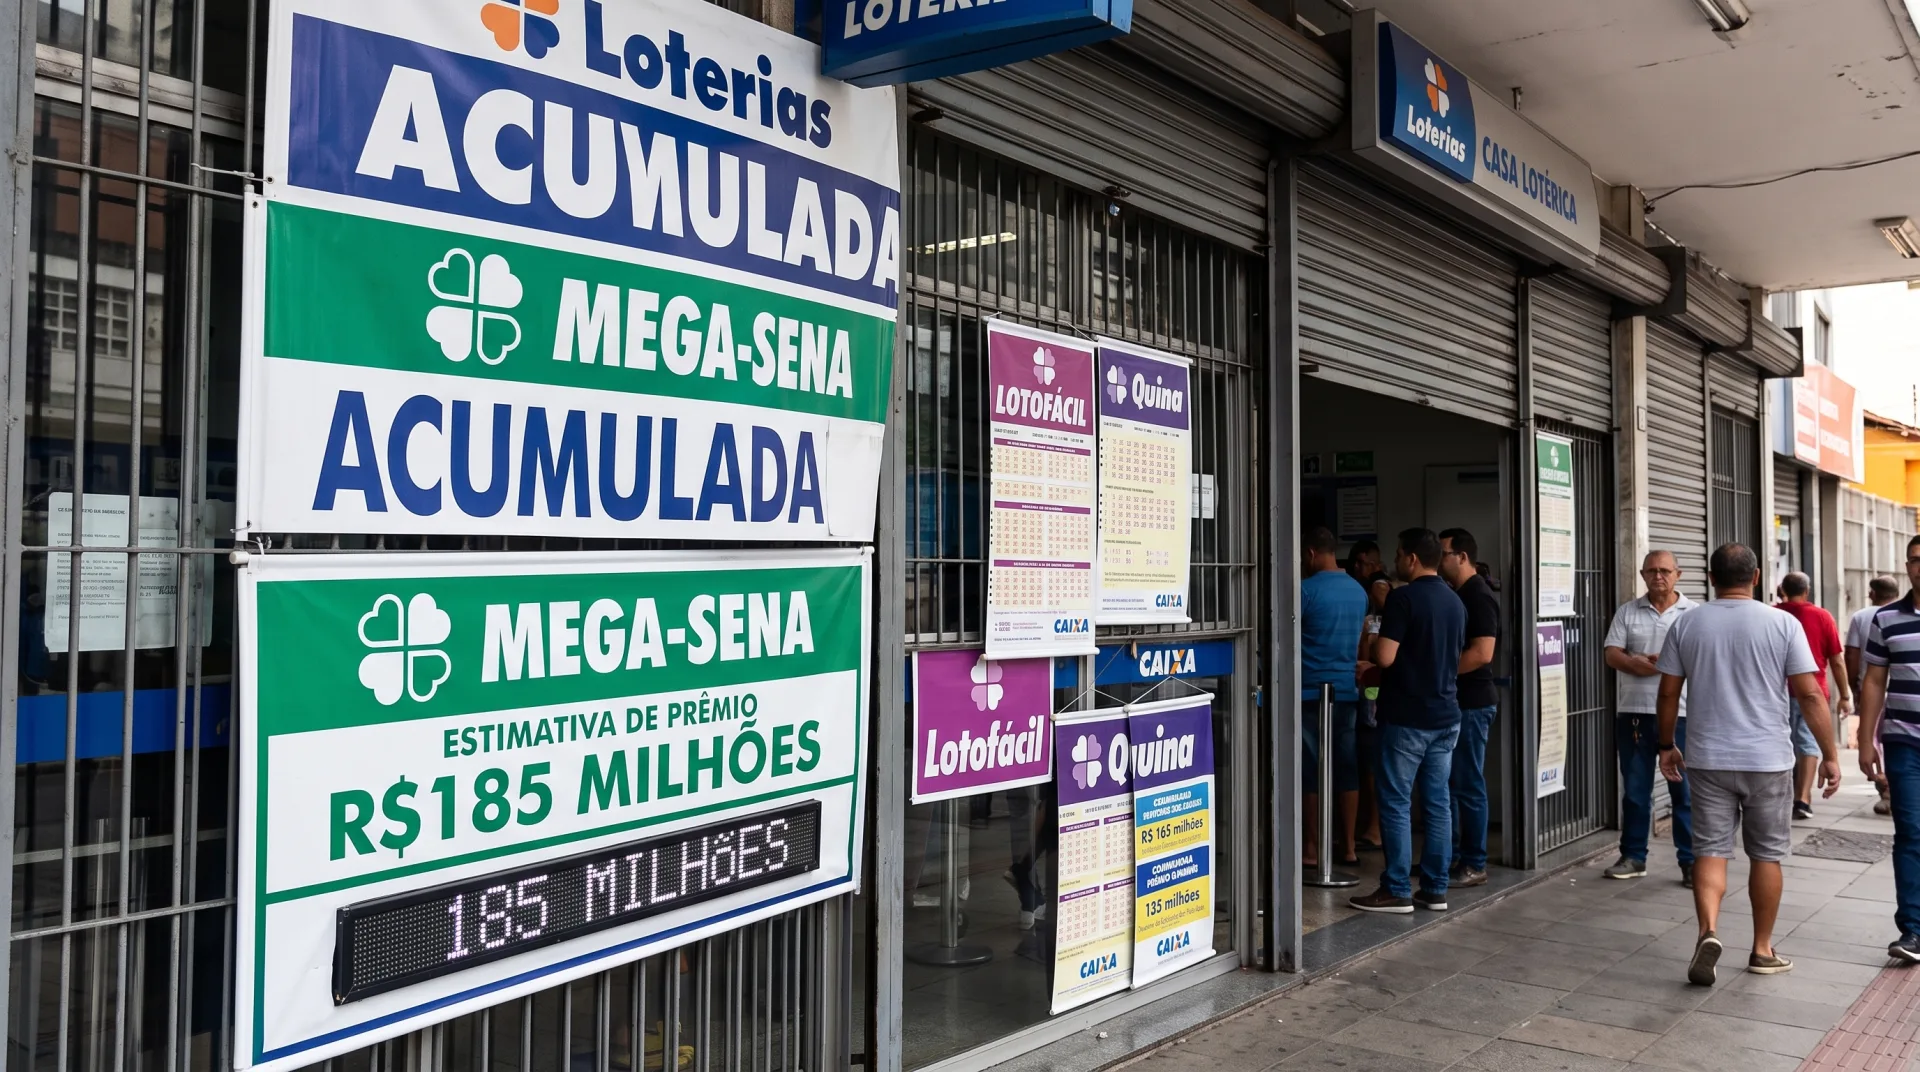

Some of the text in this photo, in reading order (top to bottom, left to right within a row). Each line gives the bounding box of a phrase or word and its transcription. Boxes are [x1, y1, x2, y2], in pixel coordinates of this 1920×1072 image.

[584, 0, 832, 149] Loterias
[1407, 104, 1466, 163] Loterias
[1483, 136, 1577, 225] CASA LOTÉRICA
[552, 277, 852, 398] MEGA-SENA
[995, 384, 1087, 427] LOTOFÁCIL
[1132, 373, 1183, 413] Quina
[312, 390, 824, 525] ACUMULADA
[1054, 618, 1089, 633] CAIXA
[1156, 594, 1182, 608] CAIXA
[481, 590, 815, 683] MEGA-SENA
[1139, 649, 1196, 678] CAIXA
[443, 692, 758, 758] ESTIMATIVA DE PRÊMIO
[924, 715, 1044, 778] Lotofácil
[577, 719, 822, 815] MILHÕES
[1142, 829, 1153, 844] R$
[1156, 824, 1171, 840] 165
[447, 875, 547, 960] 185
[1145, 899, 1162, 917] 135
[1080, 952, 1117, 979] CAIXA
[1156, 930, 1190, 957] CAIXA
